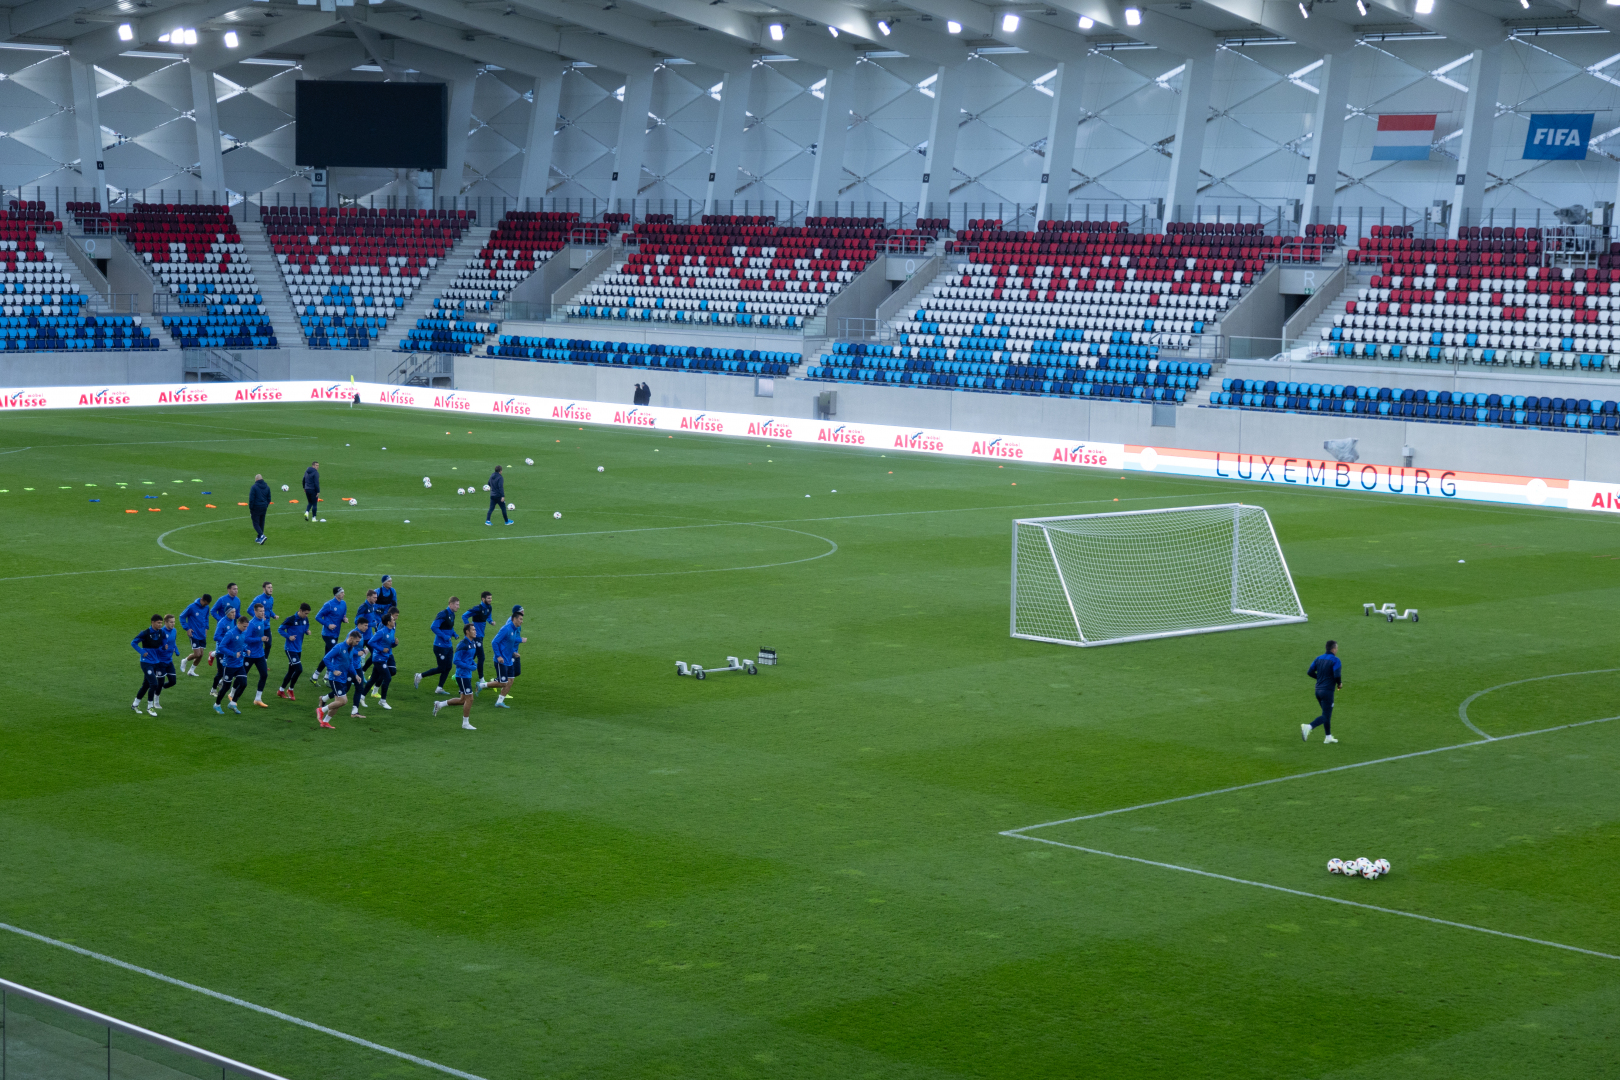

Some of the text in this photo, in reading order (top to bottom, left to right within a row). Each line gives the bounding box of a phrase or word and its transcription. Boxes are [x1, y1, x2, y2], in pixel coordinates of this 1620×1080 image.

[1533, 128, 1580, 146] FIFA
[586, 249, 593, 262] P
[906, 259, 915, 273] Q
[1304, 270, 1315, 287] R
[79, 392, 130, 405] Alvisse
[158, 390, 207, 403] Alvisse
[235, 389, 282, 400] Alvisse
[380, 391, 414, 404] Alvisse
[434, 396, 470, 410] Alvisse
[493, 401, 530, 415] Alvisse
[552, 406, 591, 420] Alvisse
[680, 417, 723, 432] Alvisse
[747, 422, 792, 438] Alvisse
[818, 428, 865, 444] Alvisse
[894, 435, 943, 451] Alvisse
[971, 441, 1023, 458] Alvisse
[1053, 448, 1107, 465] Alvisse
[1216, 453, 1456, 497] LUXEMBOURG
